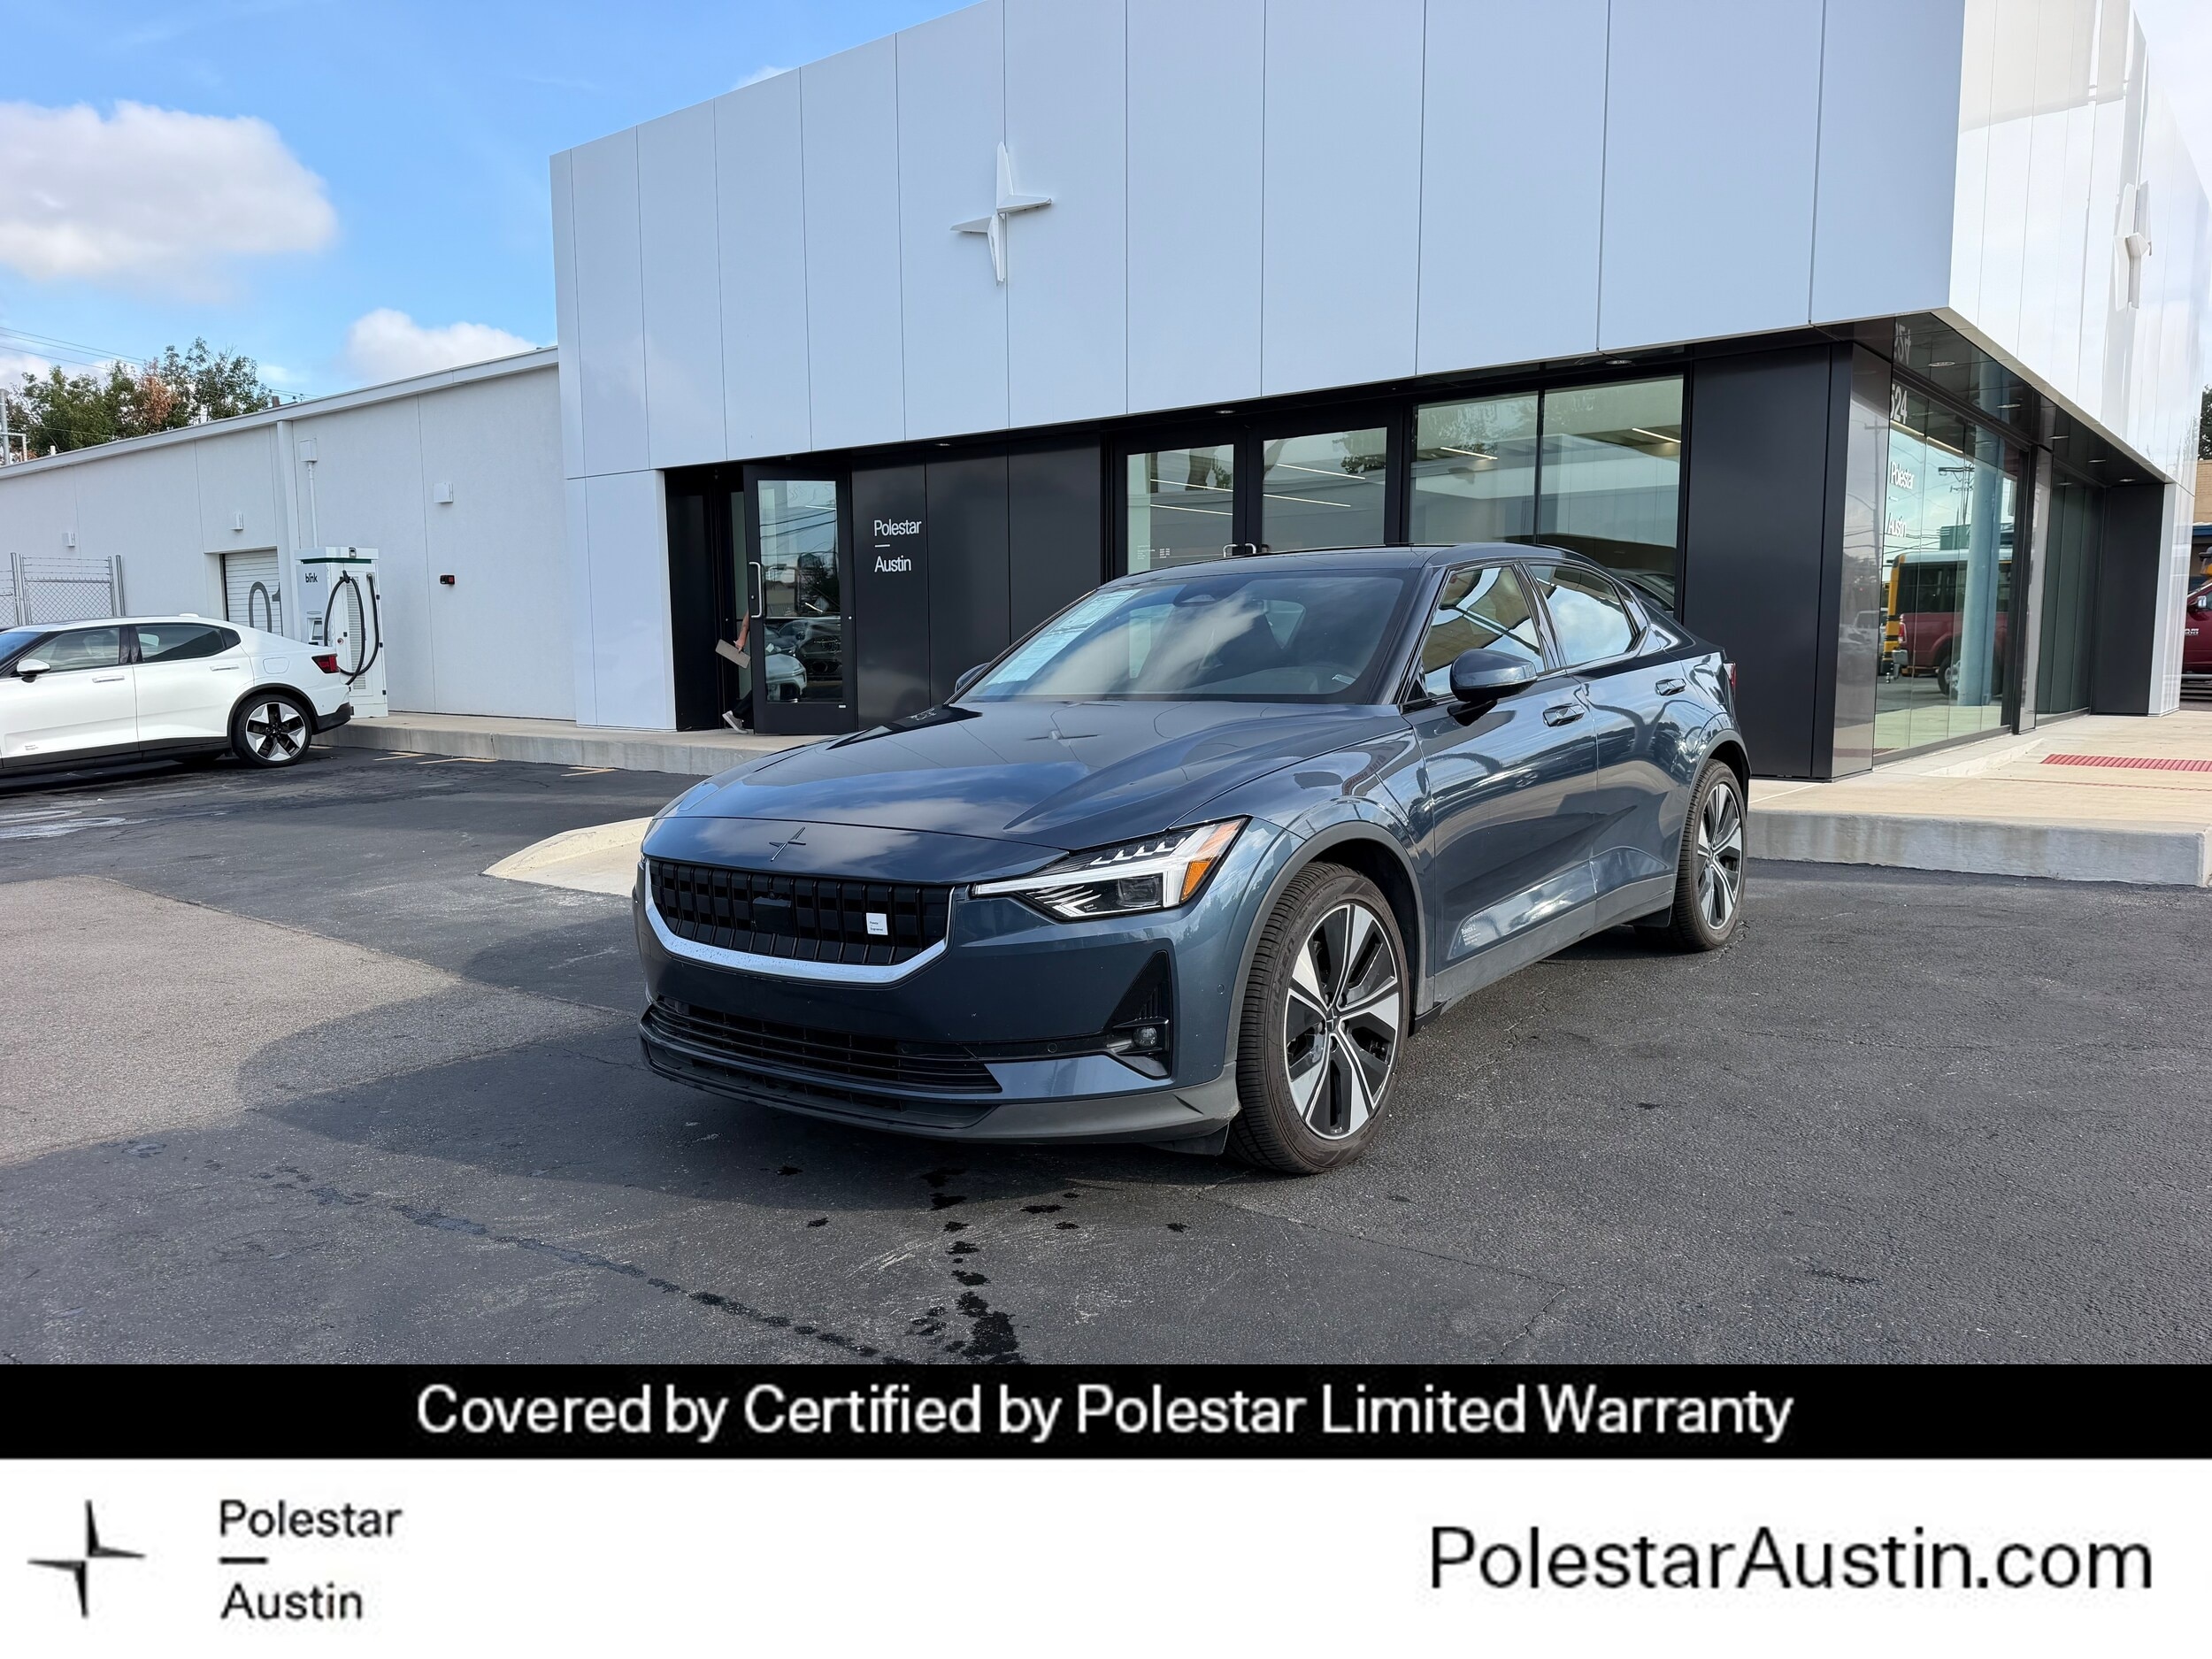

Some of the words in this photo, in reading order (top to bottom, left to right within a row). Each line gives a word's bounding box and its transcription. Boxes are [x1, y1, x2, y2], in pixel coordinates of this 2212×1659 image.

[1889, 461, 1915, 490] Polestar
[874, 518, 922, 536] Polestar
[1887, 512, 1907, 537] Austin
[874, 555, 911, 572] Austin
[304, 572, 319, 583] blink
